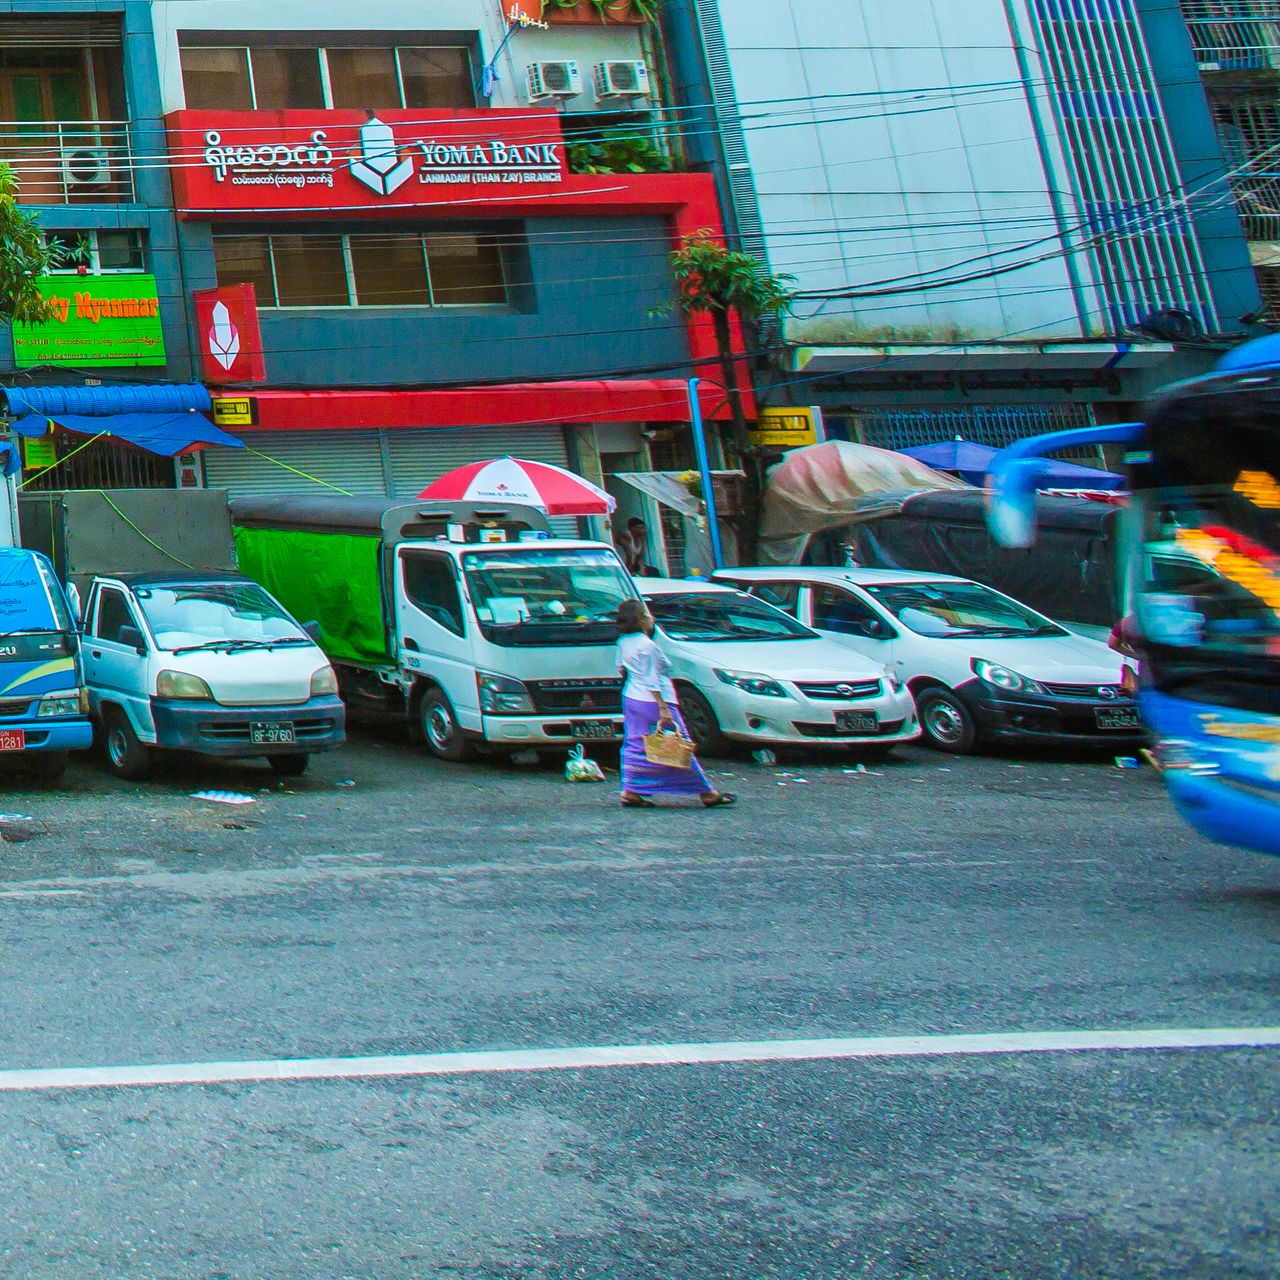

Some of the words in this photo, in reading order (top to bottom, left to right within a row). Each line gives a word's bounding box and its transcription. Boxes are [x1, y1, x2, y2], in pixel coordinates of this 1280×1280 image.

[416, 140, 489, 165] YOMA
[490, 140, 561, 164] BANK
[419, 173, 471, 184] LANMADAW
[524, 173, 562, 183] BRANCH
[74, 292, 158, 323] Myanmar
[253, 729, 292, 742] 8F-9760
